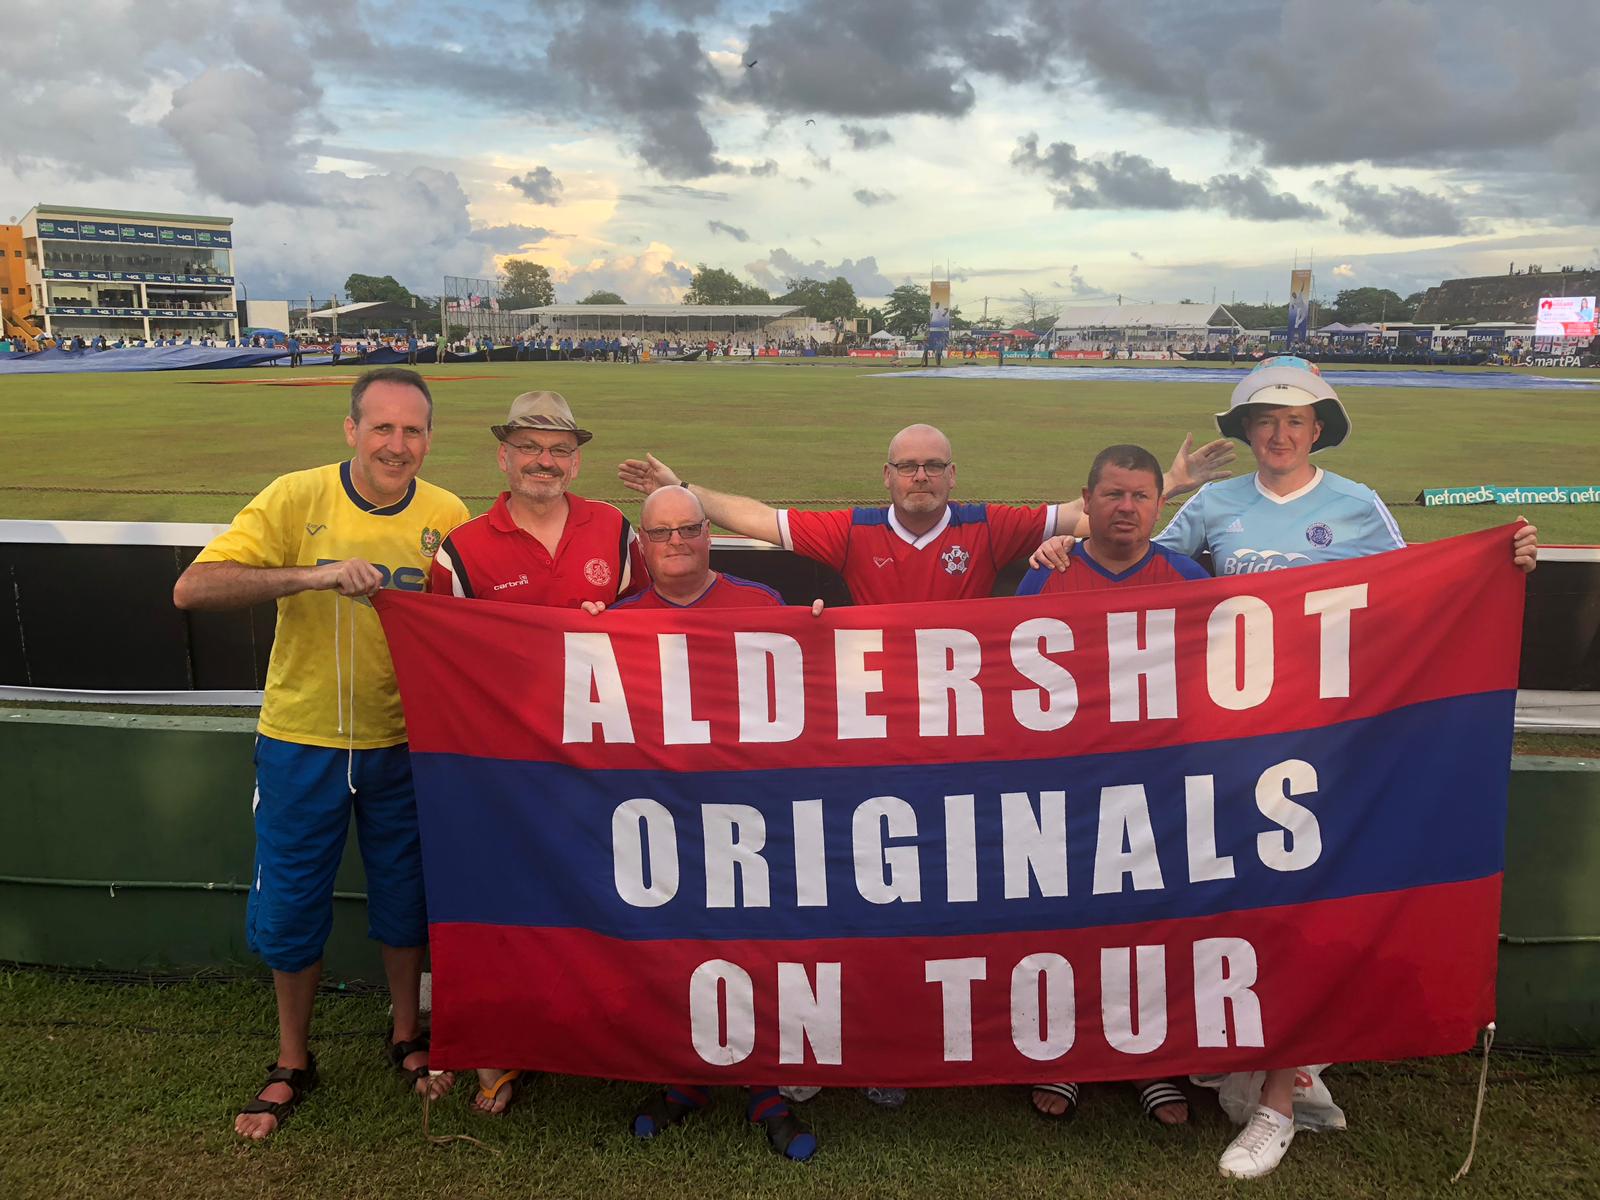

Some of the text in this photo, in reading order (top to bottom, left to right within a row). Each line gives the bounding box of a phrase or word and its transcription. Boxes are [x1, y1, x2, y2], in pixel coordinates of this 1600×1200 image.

[1526, 355, 1581, 367] SmartPA
[1425, 486, 1495, 506] netmeds
[562, 583, 1369, 745] ALDERSHOT
[611, 758, 1323, 908] ORIGINALS
[689, 937, 1266, 1066] ON TOUR
